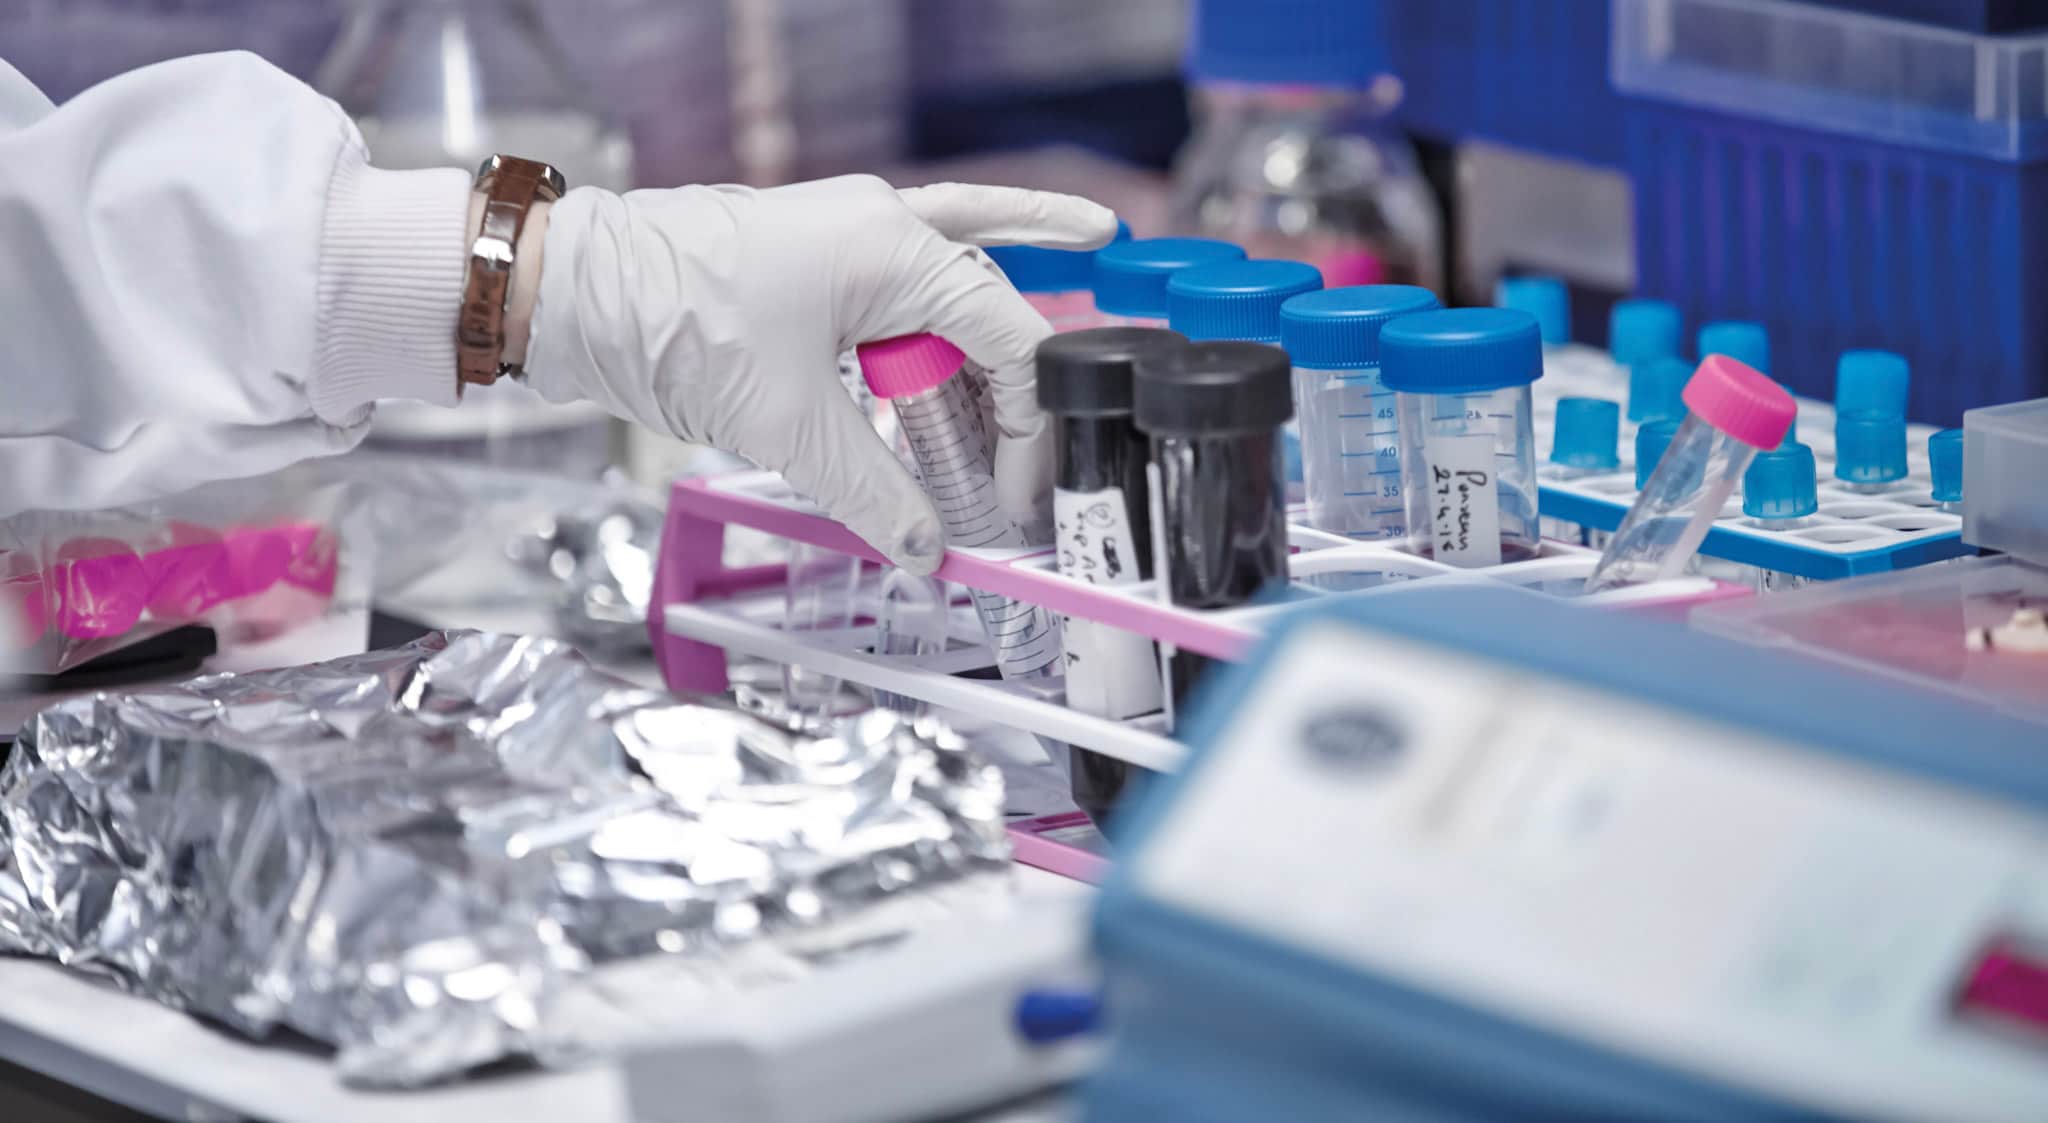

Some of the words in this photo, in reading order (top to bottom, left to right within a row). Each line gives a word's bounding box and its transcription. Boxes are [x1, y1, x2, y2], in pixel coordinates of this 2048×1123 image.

[1377, 408, 1394, 418] 45
[1380, 447, 1397, 457] 40
[1383, 487, 1399, 497] 35
[1386, 526, 1402, 537] 30
